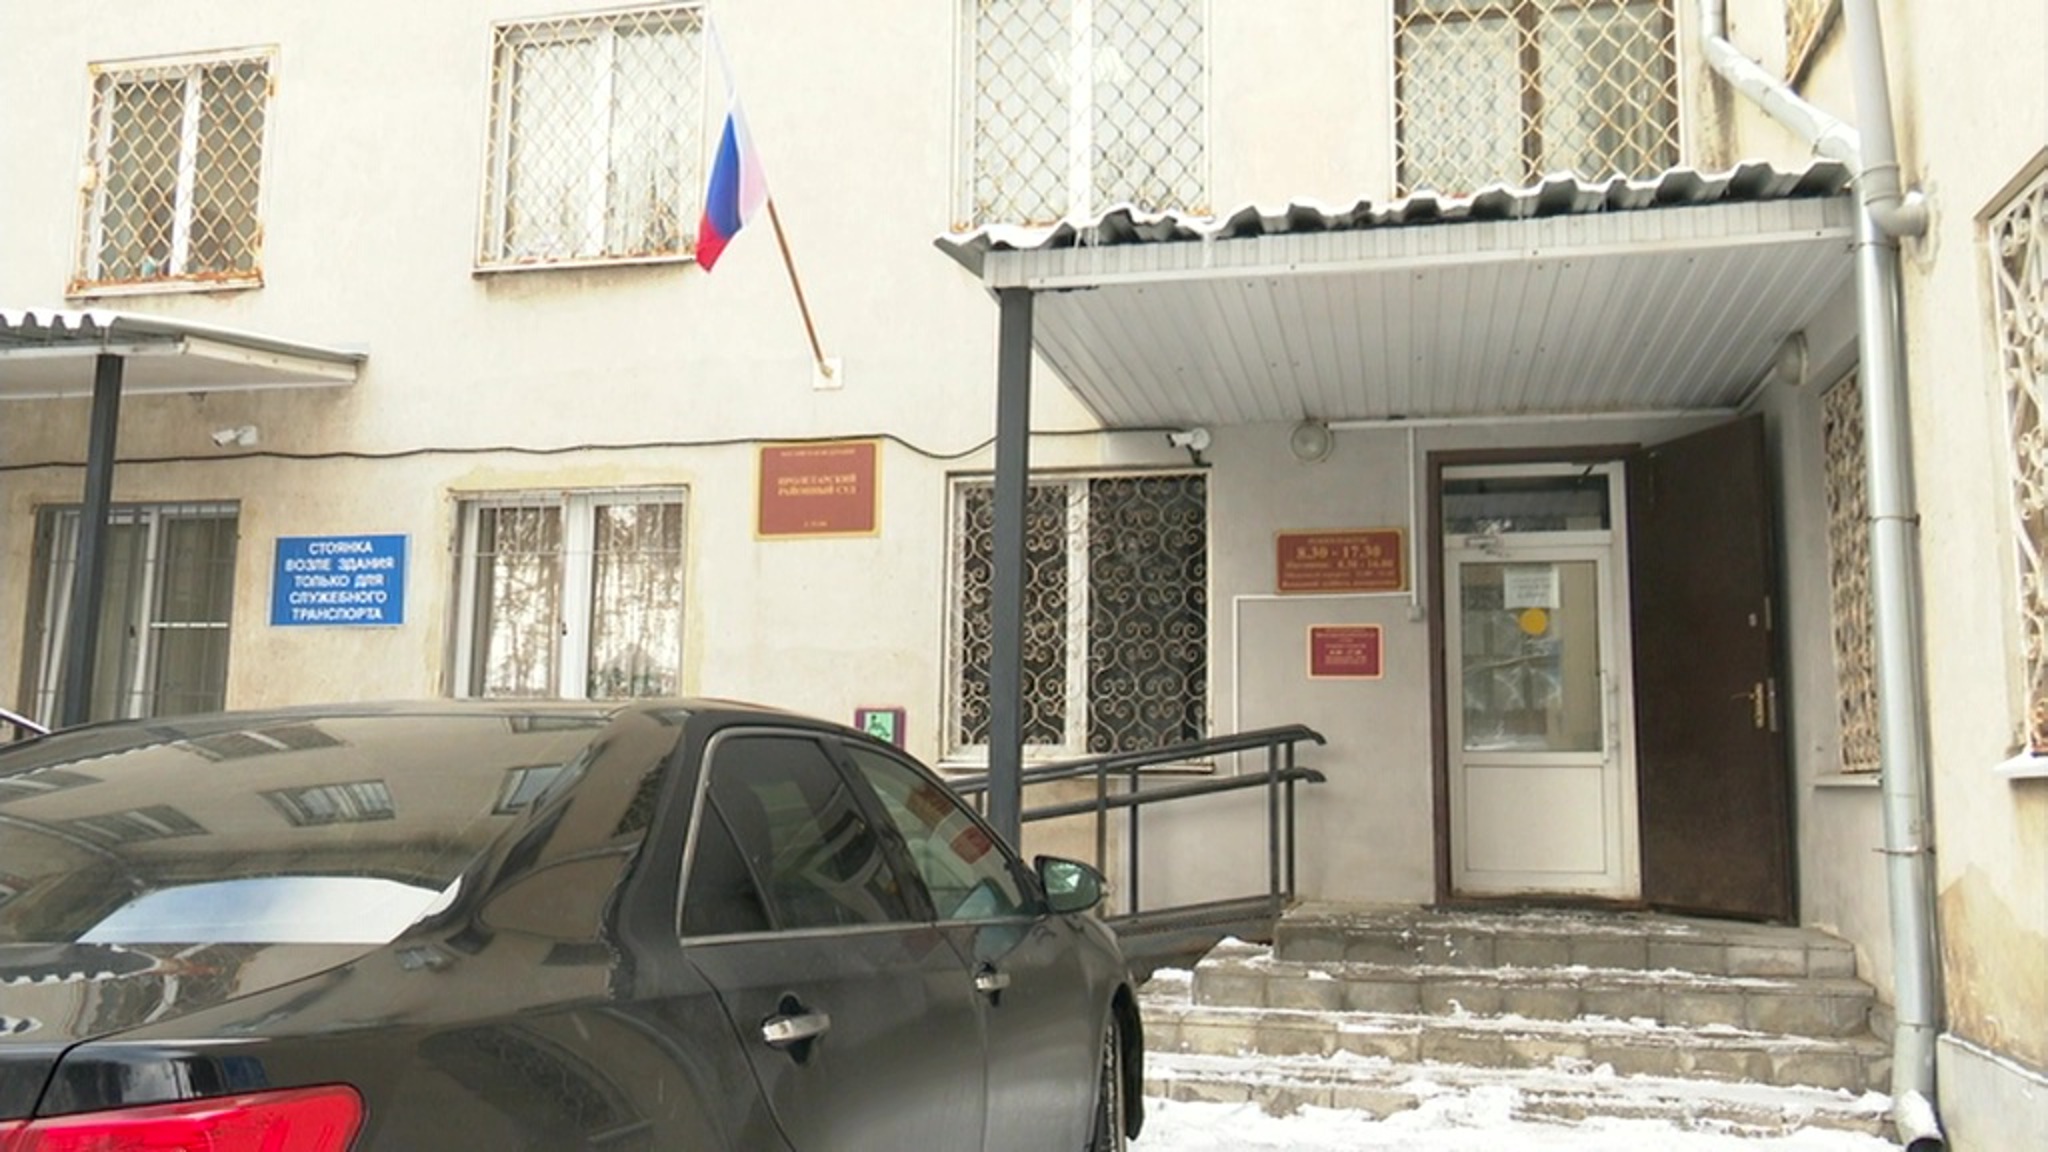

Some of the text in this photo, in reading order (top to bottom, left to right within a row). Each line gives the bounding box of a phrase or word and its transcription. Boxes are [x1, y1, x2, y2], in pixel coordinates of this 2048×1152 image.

[778, 485, 857, 496] РАЙОННЫЙ СУД
[308, 541, 373, 555] СТОЯНКА
[1296, 546, 1329, 560] 8.30
[1343, 545, 1382, 559] 17.30
[285, 556, 394, 571] ВОЗЛЕ ЗДАНИЯ
[294, 573, 385, 588] ТОЛЬКО ДЛЯ
[289, 590, 388, 604] СЛУЖЕБНОГО
[291, 607, 383, 620] ТРАНСПОРТА
